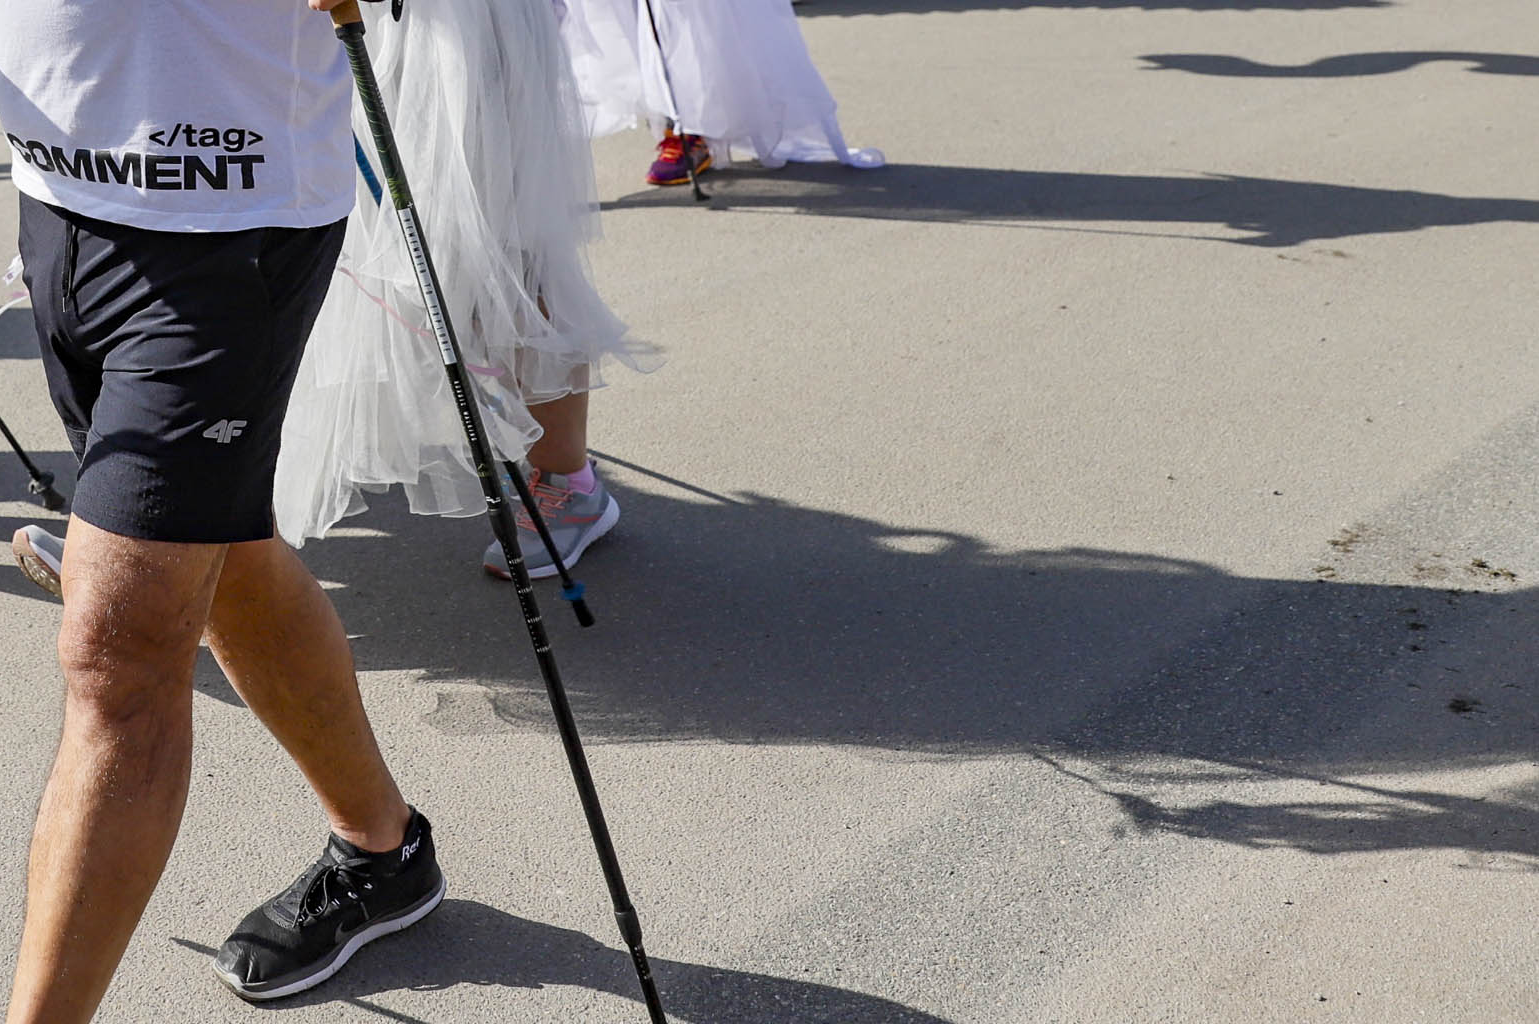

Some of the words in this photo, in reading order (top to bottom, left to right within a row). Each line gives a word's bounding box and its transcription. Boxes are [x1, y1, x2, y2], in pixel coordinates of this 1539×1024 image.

[148, 123, 264, 153] </tag>
[7, 132, 266, 191] COMMENT
[202, 419, 248, 444] 4F
